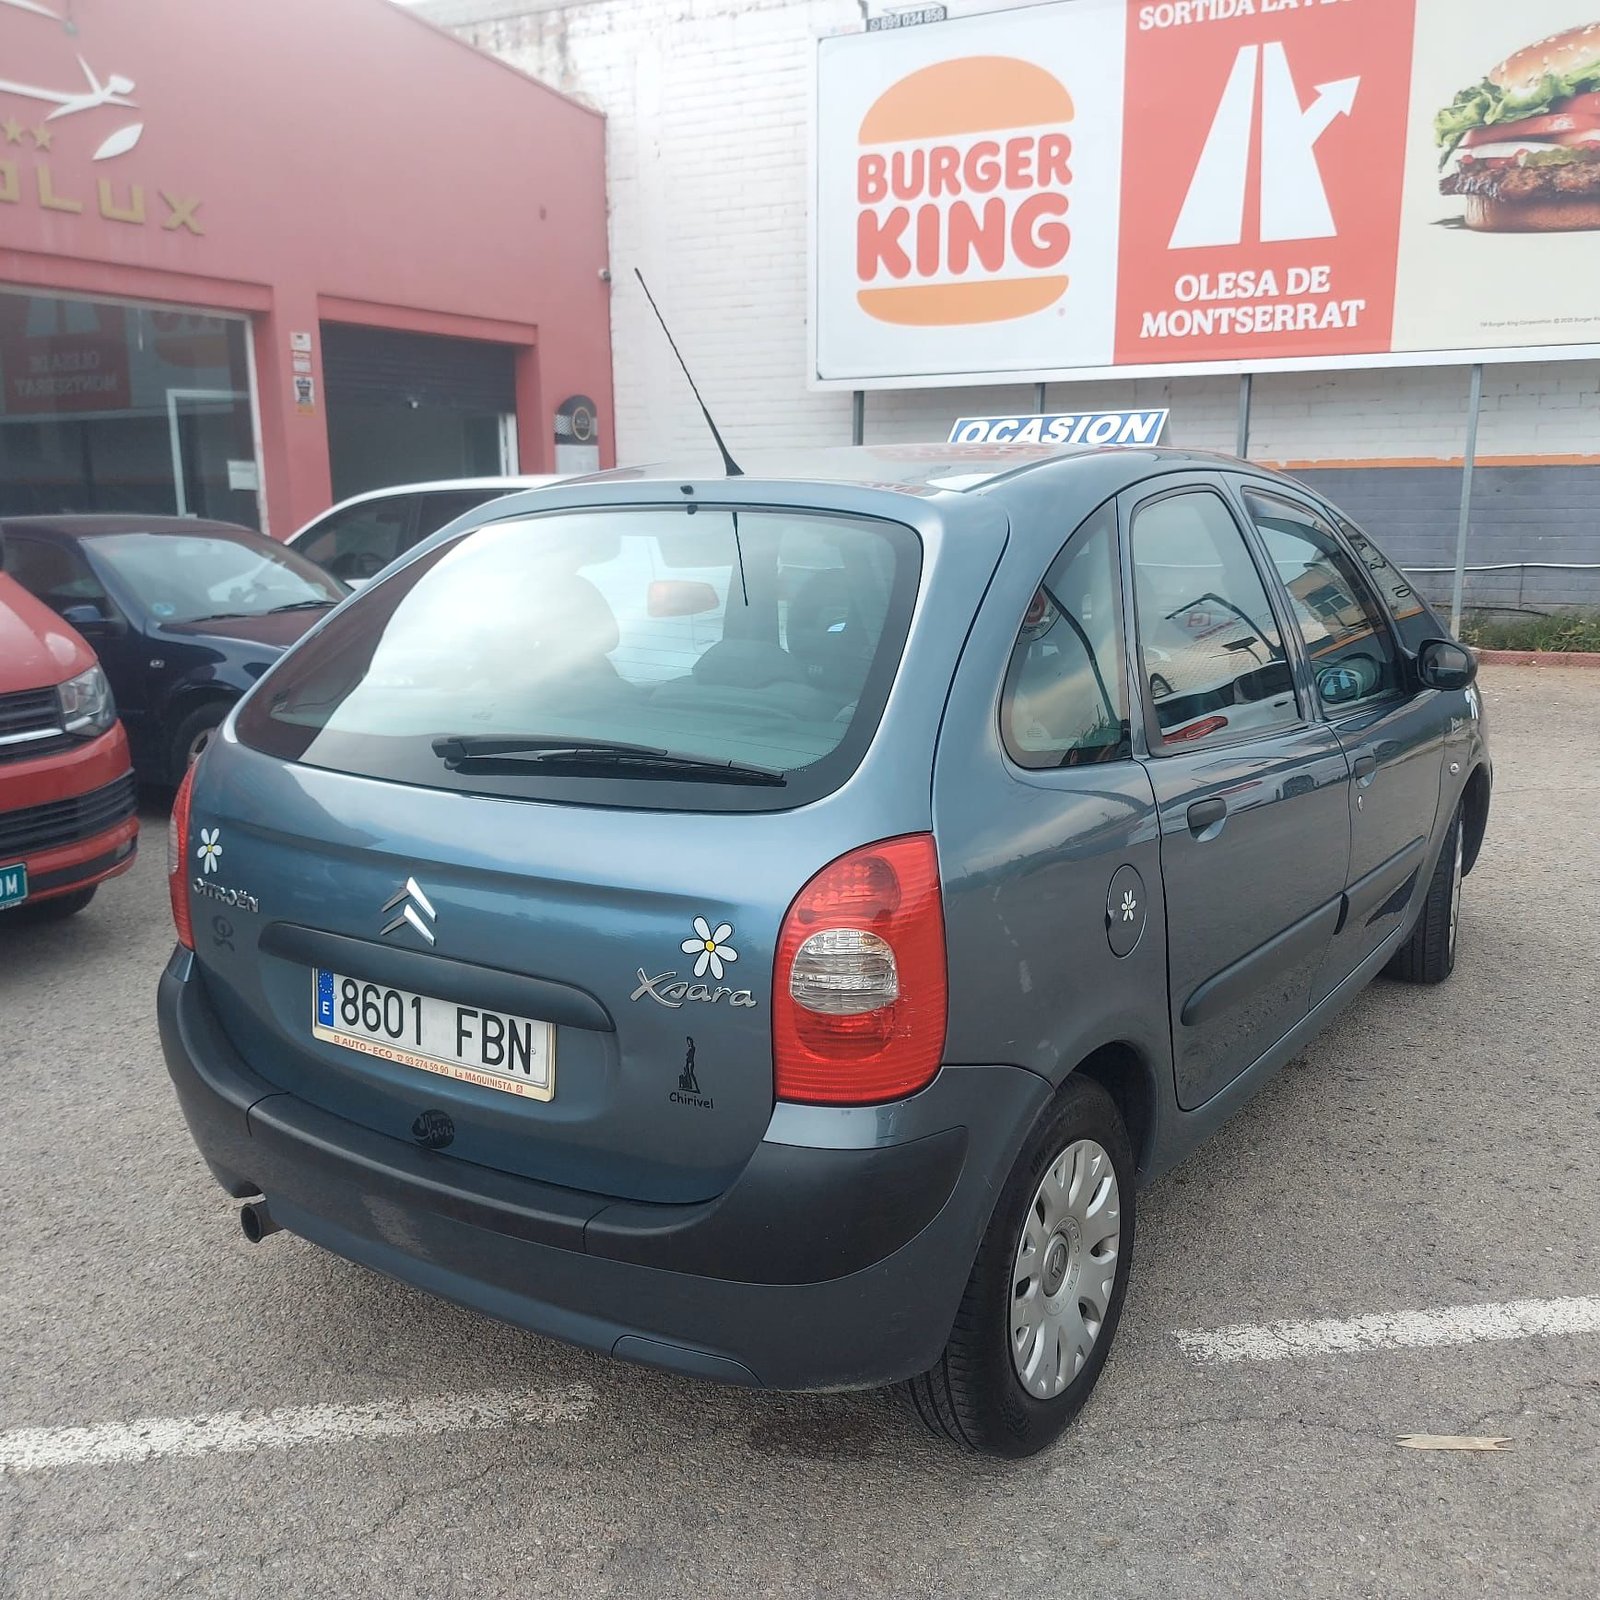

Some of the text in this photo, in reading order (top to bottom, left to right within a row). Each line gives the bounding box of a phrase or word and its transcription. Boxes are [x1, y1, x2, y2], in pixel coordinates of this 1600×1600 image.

[857, 133, 1073, 205] BURGER
[857, 192, 1071, 282] KING
[1174, 265, 1331, 302] OLESA DE
[1139, 299, 1366, 338] MONTSERRAT
[957, 413, 1159, 443] OCASION
[630, 967, 757, 1008] Xsara
[322, 1001, 330, 1016] E
[341, 978, 532, 1075] 8601 FBN
[464, 1071, 512, 1092] MAQUINISTA
[669, 1092, 714, 1110] Chirivel
